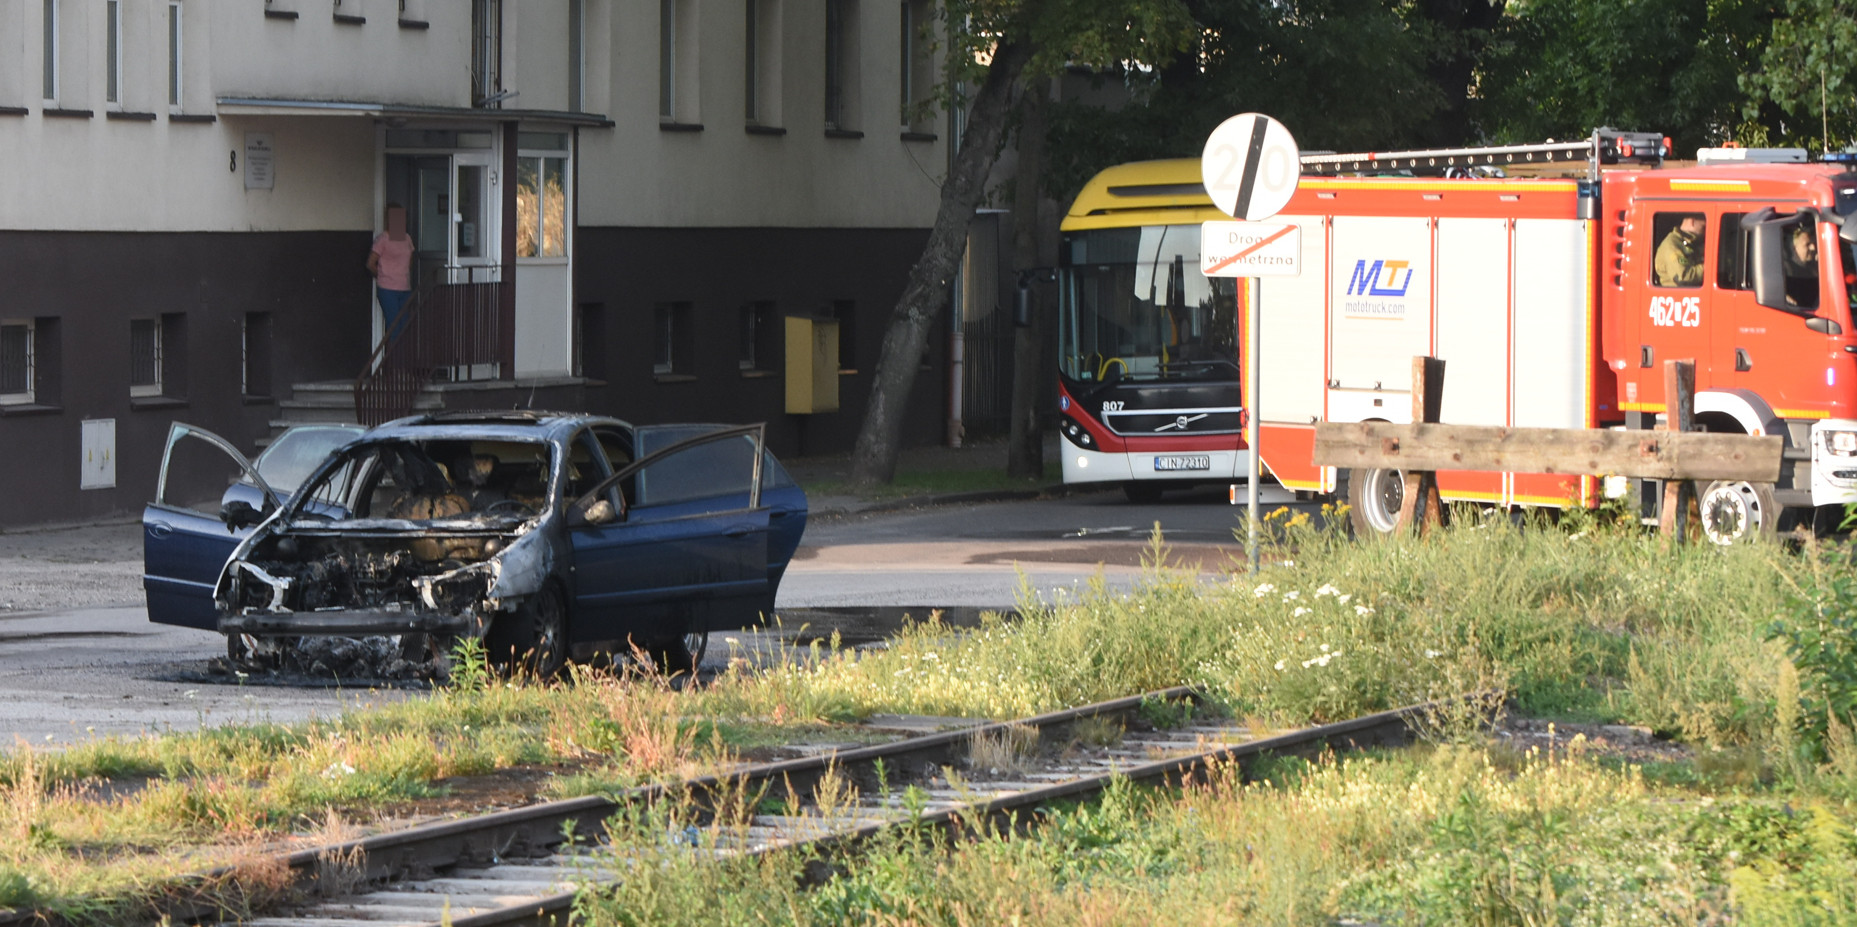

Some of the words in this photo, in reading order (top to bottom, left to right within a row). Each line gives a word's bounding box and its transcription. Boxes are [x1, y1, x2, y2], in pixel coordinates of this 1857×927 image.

[230, 150, 236, 172] 8
[1212, 144, 1290, 192] 20
[1229, 232, 1272, 246] Drog
[1345, 301, 1405, 315] mototruck.com
[1102, 401, 1125, 411] 807
